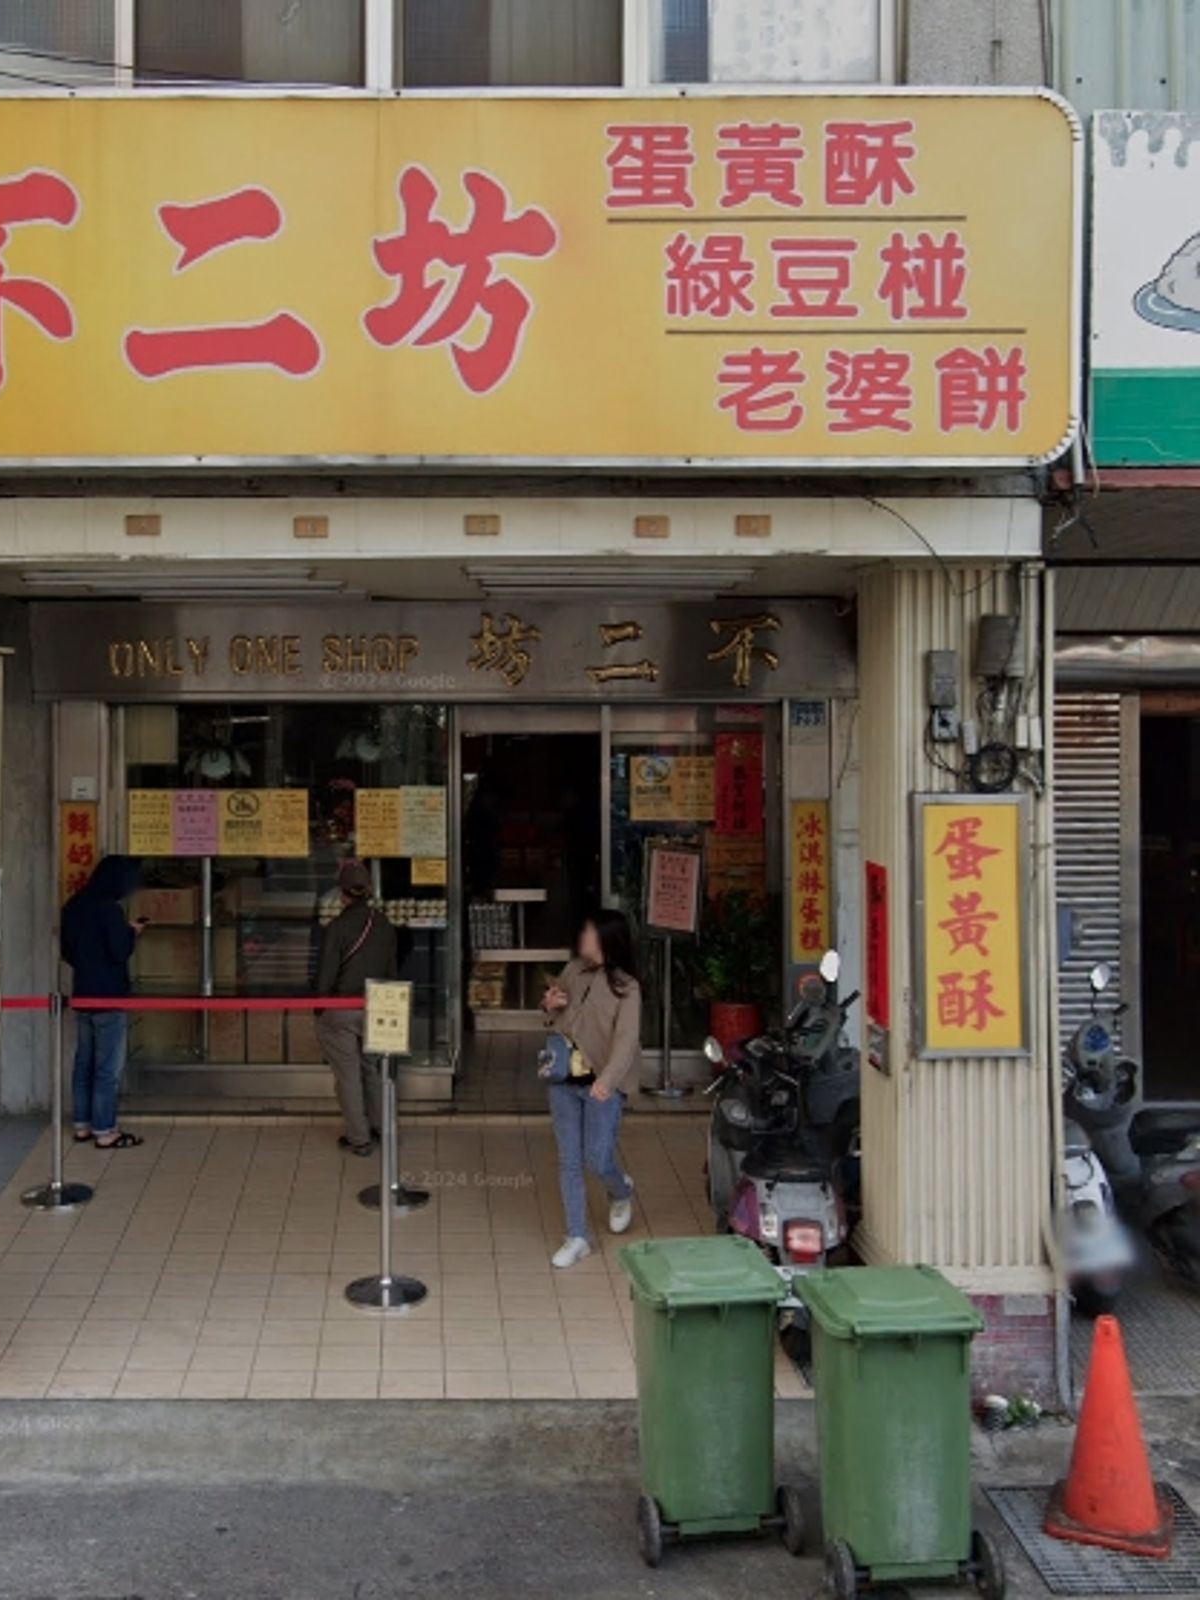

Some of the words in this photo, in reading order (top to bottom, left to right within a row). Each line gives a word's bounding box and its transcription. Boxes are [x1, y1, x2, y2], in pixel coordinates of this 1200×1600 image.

[608, 124, 912, 206] 蛋黃酥
[669, 235, 964, 317] 綠豆椪
[720, 349, 1024, 431] 老婆餅
[108, 636, 209, 678] ONLY
[228, 634, 302, 676] ONE
[320, 633, 419, 676] SHOP
[934, 816, 1006, 1031] 蛋黃酥
